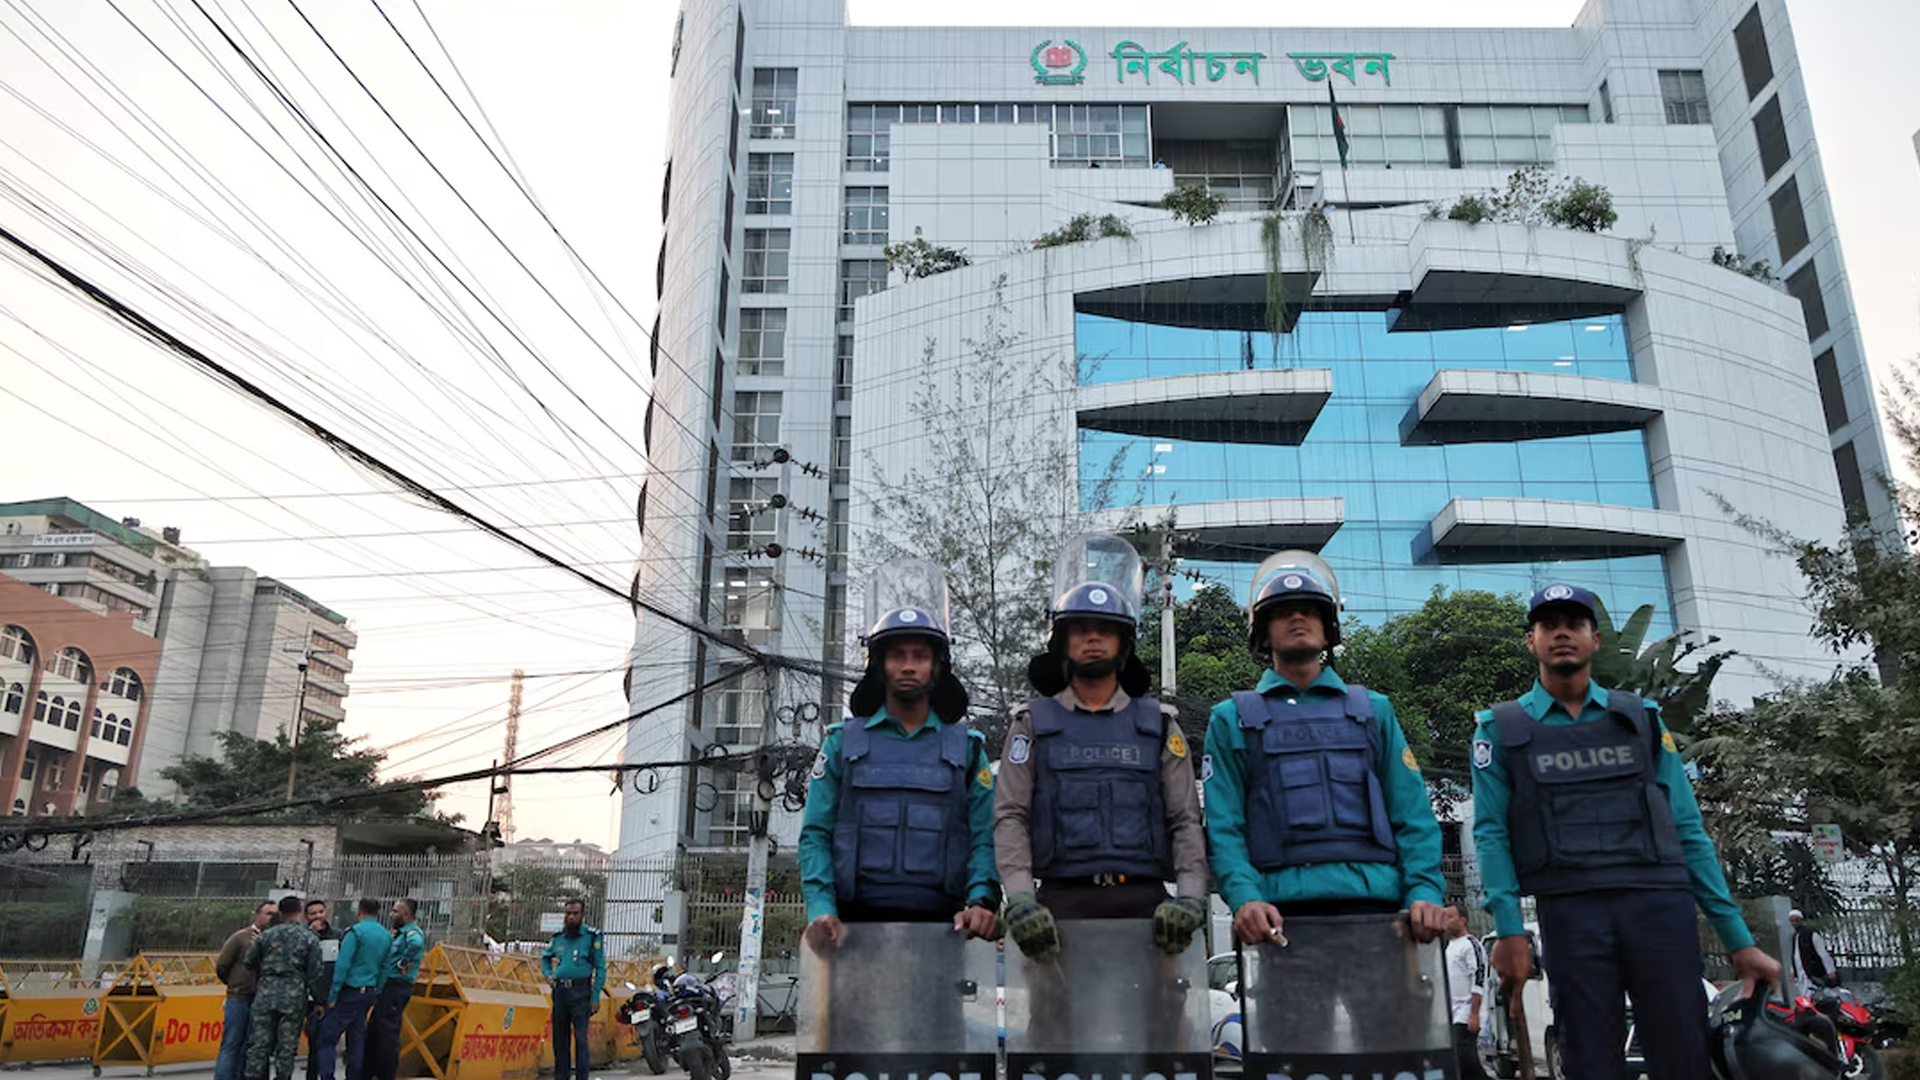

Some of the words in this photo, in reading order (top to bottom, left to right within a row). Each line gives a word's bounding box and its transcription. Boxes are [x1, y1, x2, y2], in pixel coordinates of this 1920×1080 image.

[1108, 40, 1267, 85] নির্বাচন
[1286, 52, 1397, 86] ভবন
[1537, 746, 1634, 773] POLICE
[13, 1013, 76, 1041] অতিক্রম
[165, 1018, 190, 1045] Do
[198, 1021, 225, 1042] no
